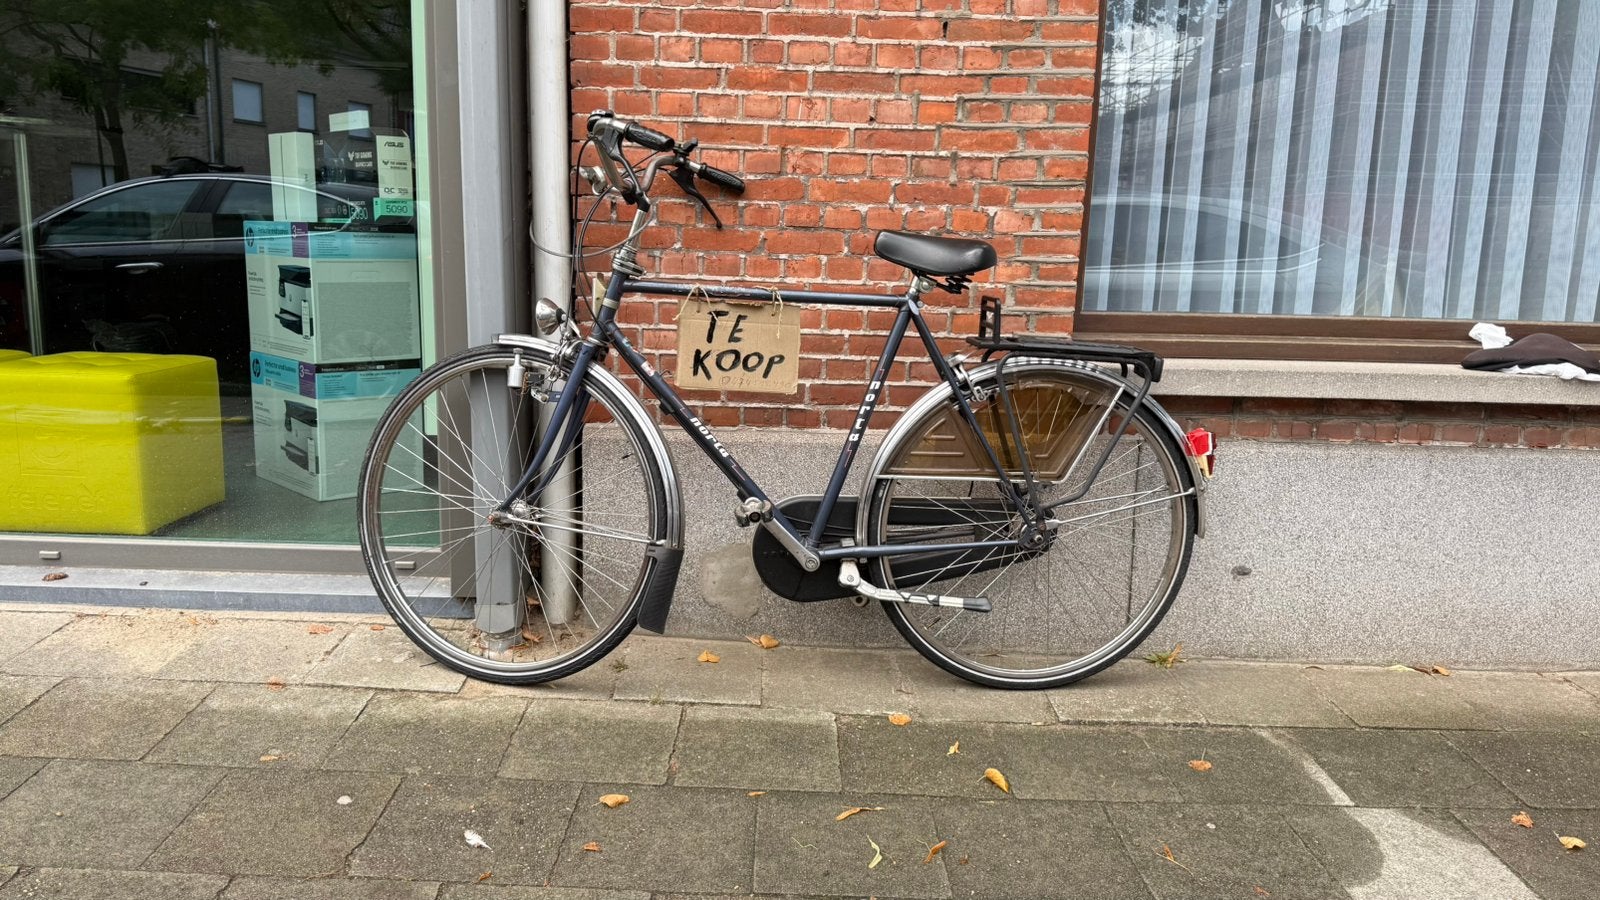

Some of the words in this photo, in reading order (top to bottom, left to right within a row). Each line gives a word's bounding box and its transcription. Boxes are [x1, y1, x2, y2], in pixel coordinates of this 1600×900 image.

[386, 205, 408, 213] 5090
[706, 309, 748, 344] TE
[299, 365, 305, 378] 3
[693, 348, 785, 381] KOOP
[848, 380, 881, 442] norta
[689, 416, 730, 458] norta
